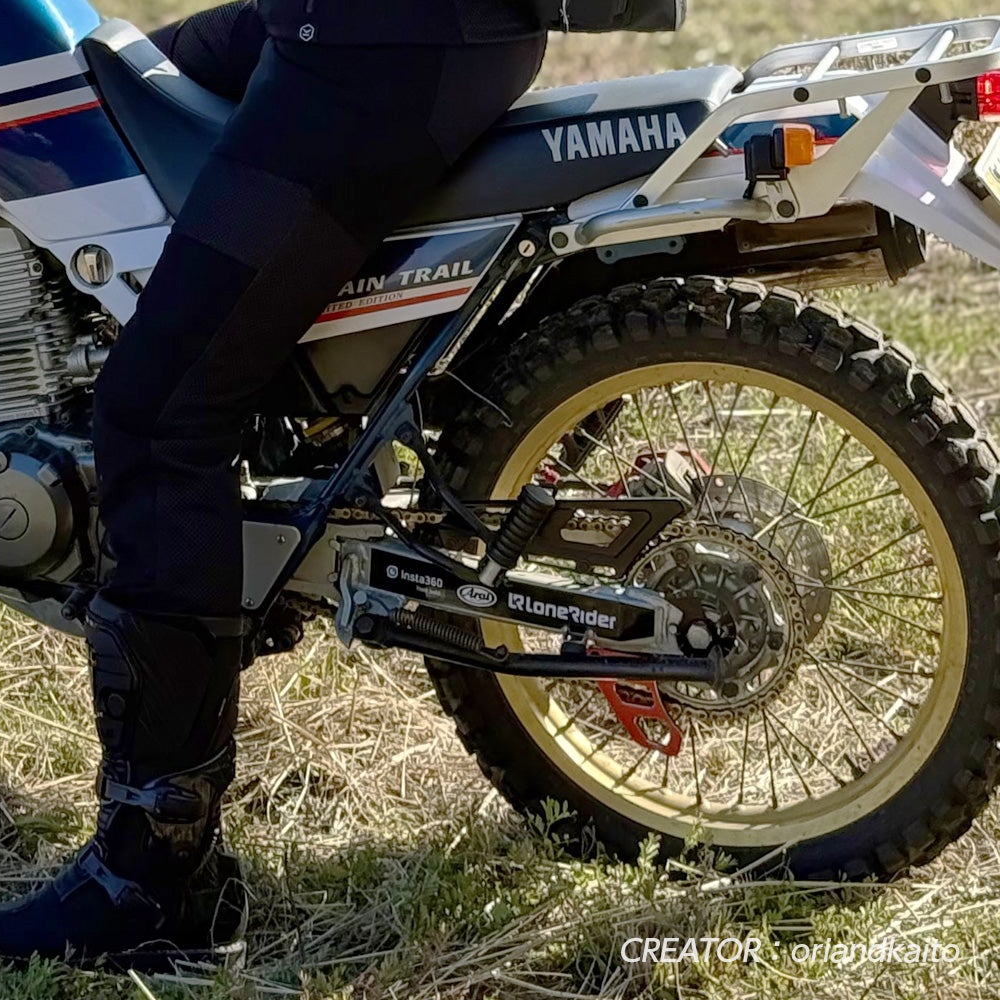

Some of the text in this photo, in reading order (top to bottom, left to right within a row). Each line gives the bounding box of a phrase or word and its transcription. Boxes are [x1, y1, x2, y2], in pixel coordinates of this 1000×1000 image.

[541, 112, 688, 163] YAMAHA
[399, 260, 474, 286] TRAIL
[358, 292, 404, 307] EDITION
[401, 569, 443, 588] Insta360
[460, 584, 491, 600] Arai
[525, 599, 617, 630] LoneRider
